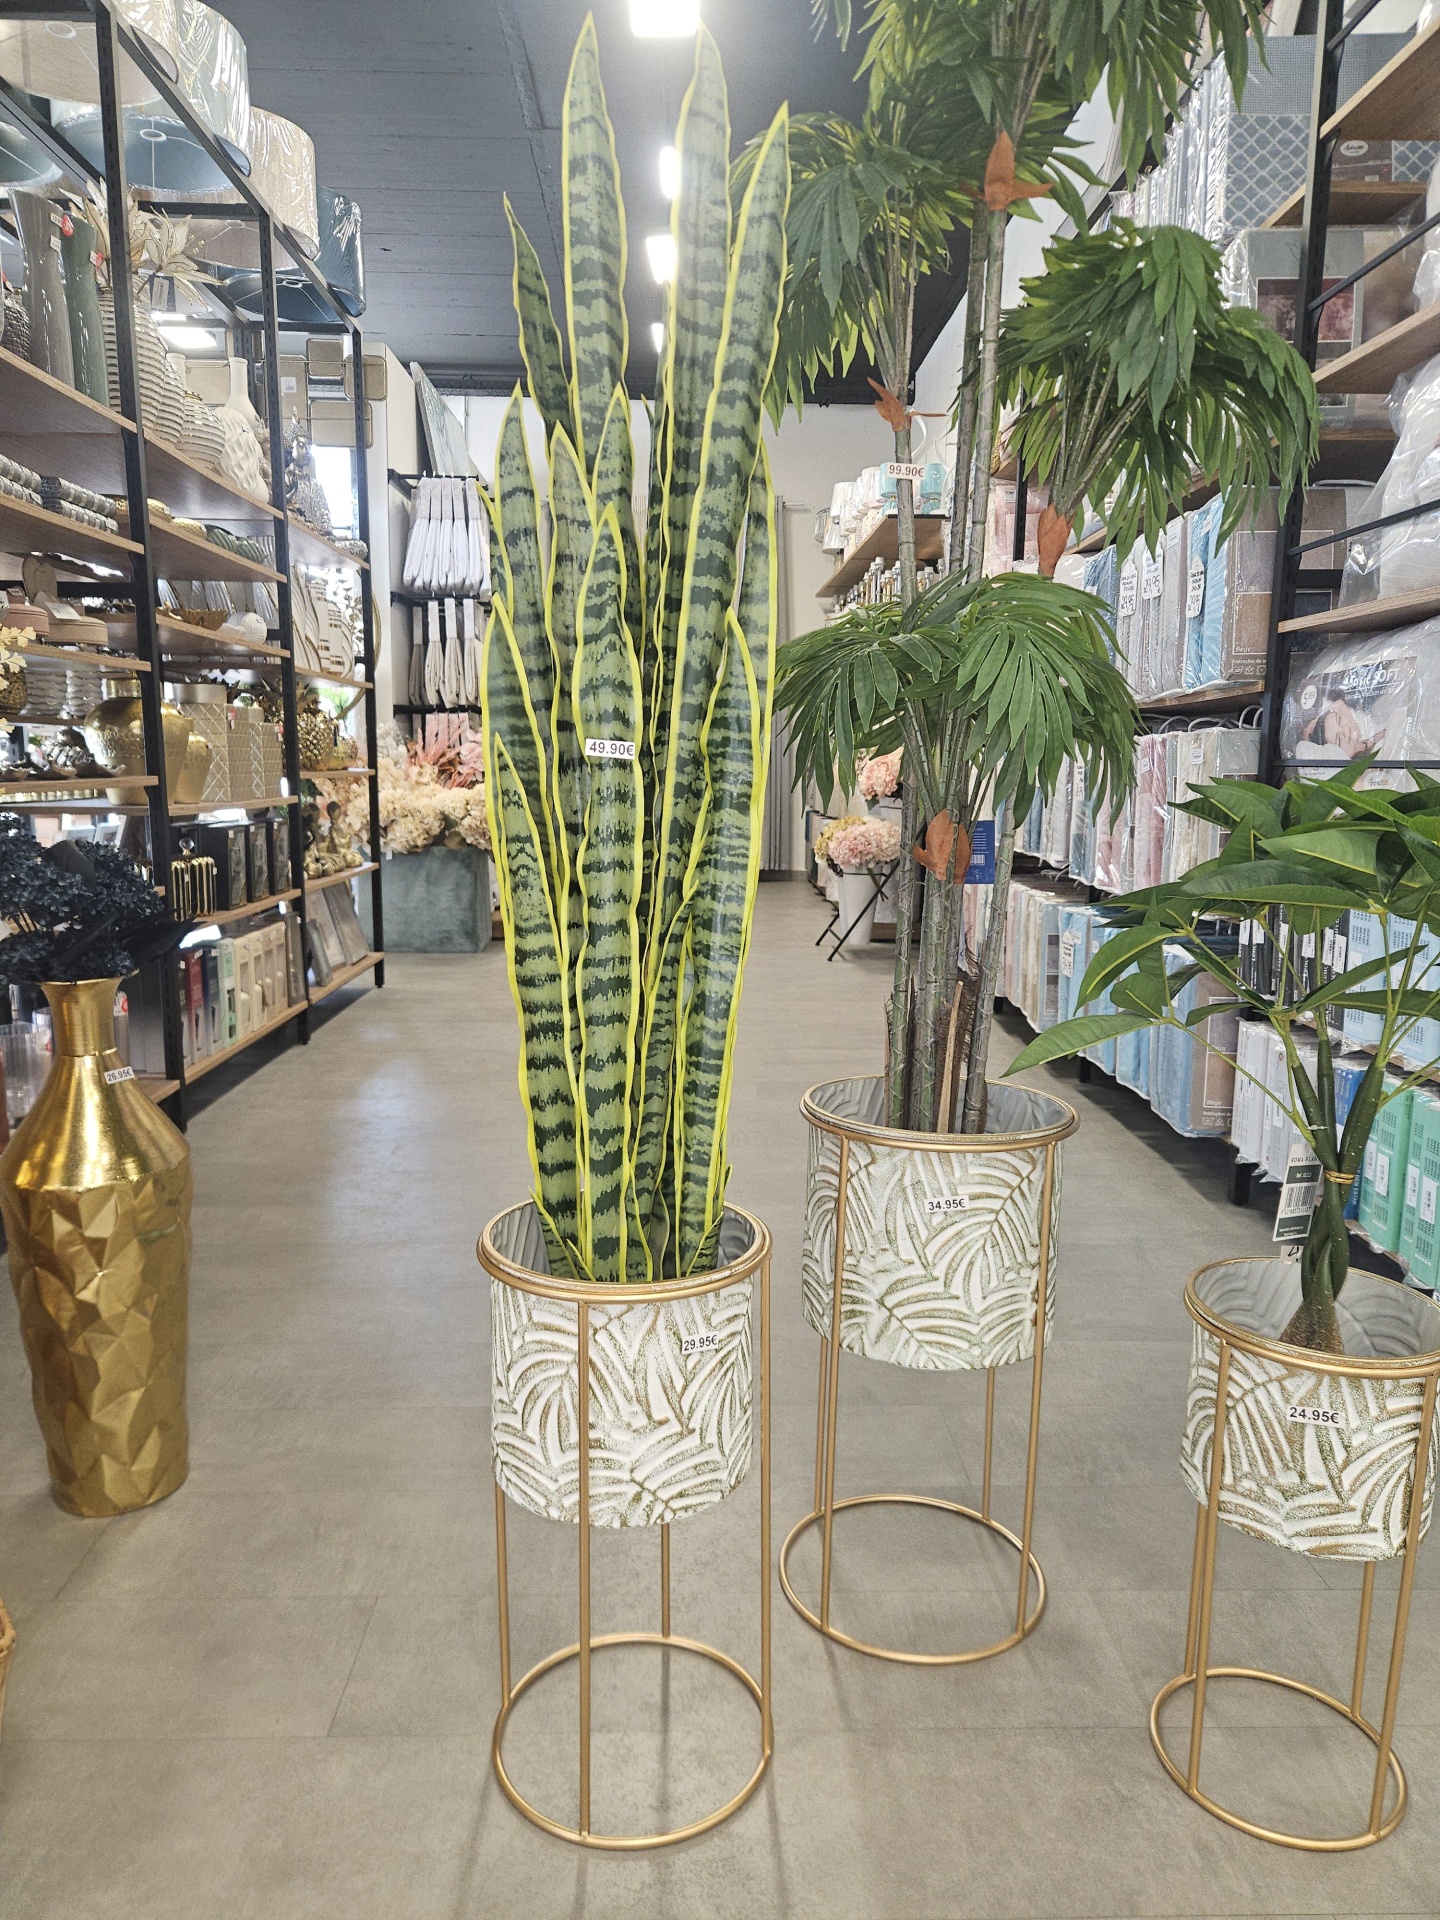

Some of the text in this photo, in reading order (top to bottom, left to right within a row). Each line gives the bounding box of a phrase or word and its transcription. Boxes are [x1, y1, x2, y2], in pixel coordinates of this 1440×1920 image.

[889, 464, 925, 478] 99.90€
[589, 741, 635, 757] 49.90€
[106, 1068, 132, 1081] 26.95€
[928, 1198, 966, 1211] 34.95€
[683, 1334, 718, 1351] 29.95€
[1290, 1406, 1340, 1424] 24.95€
